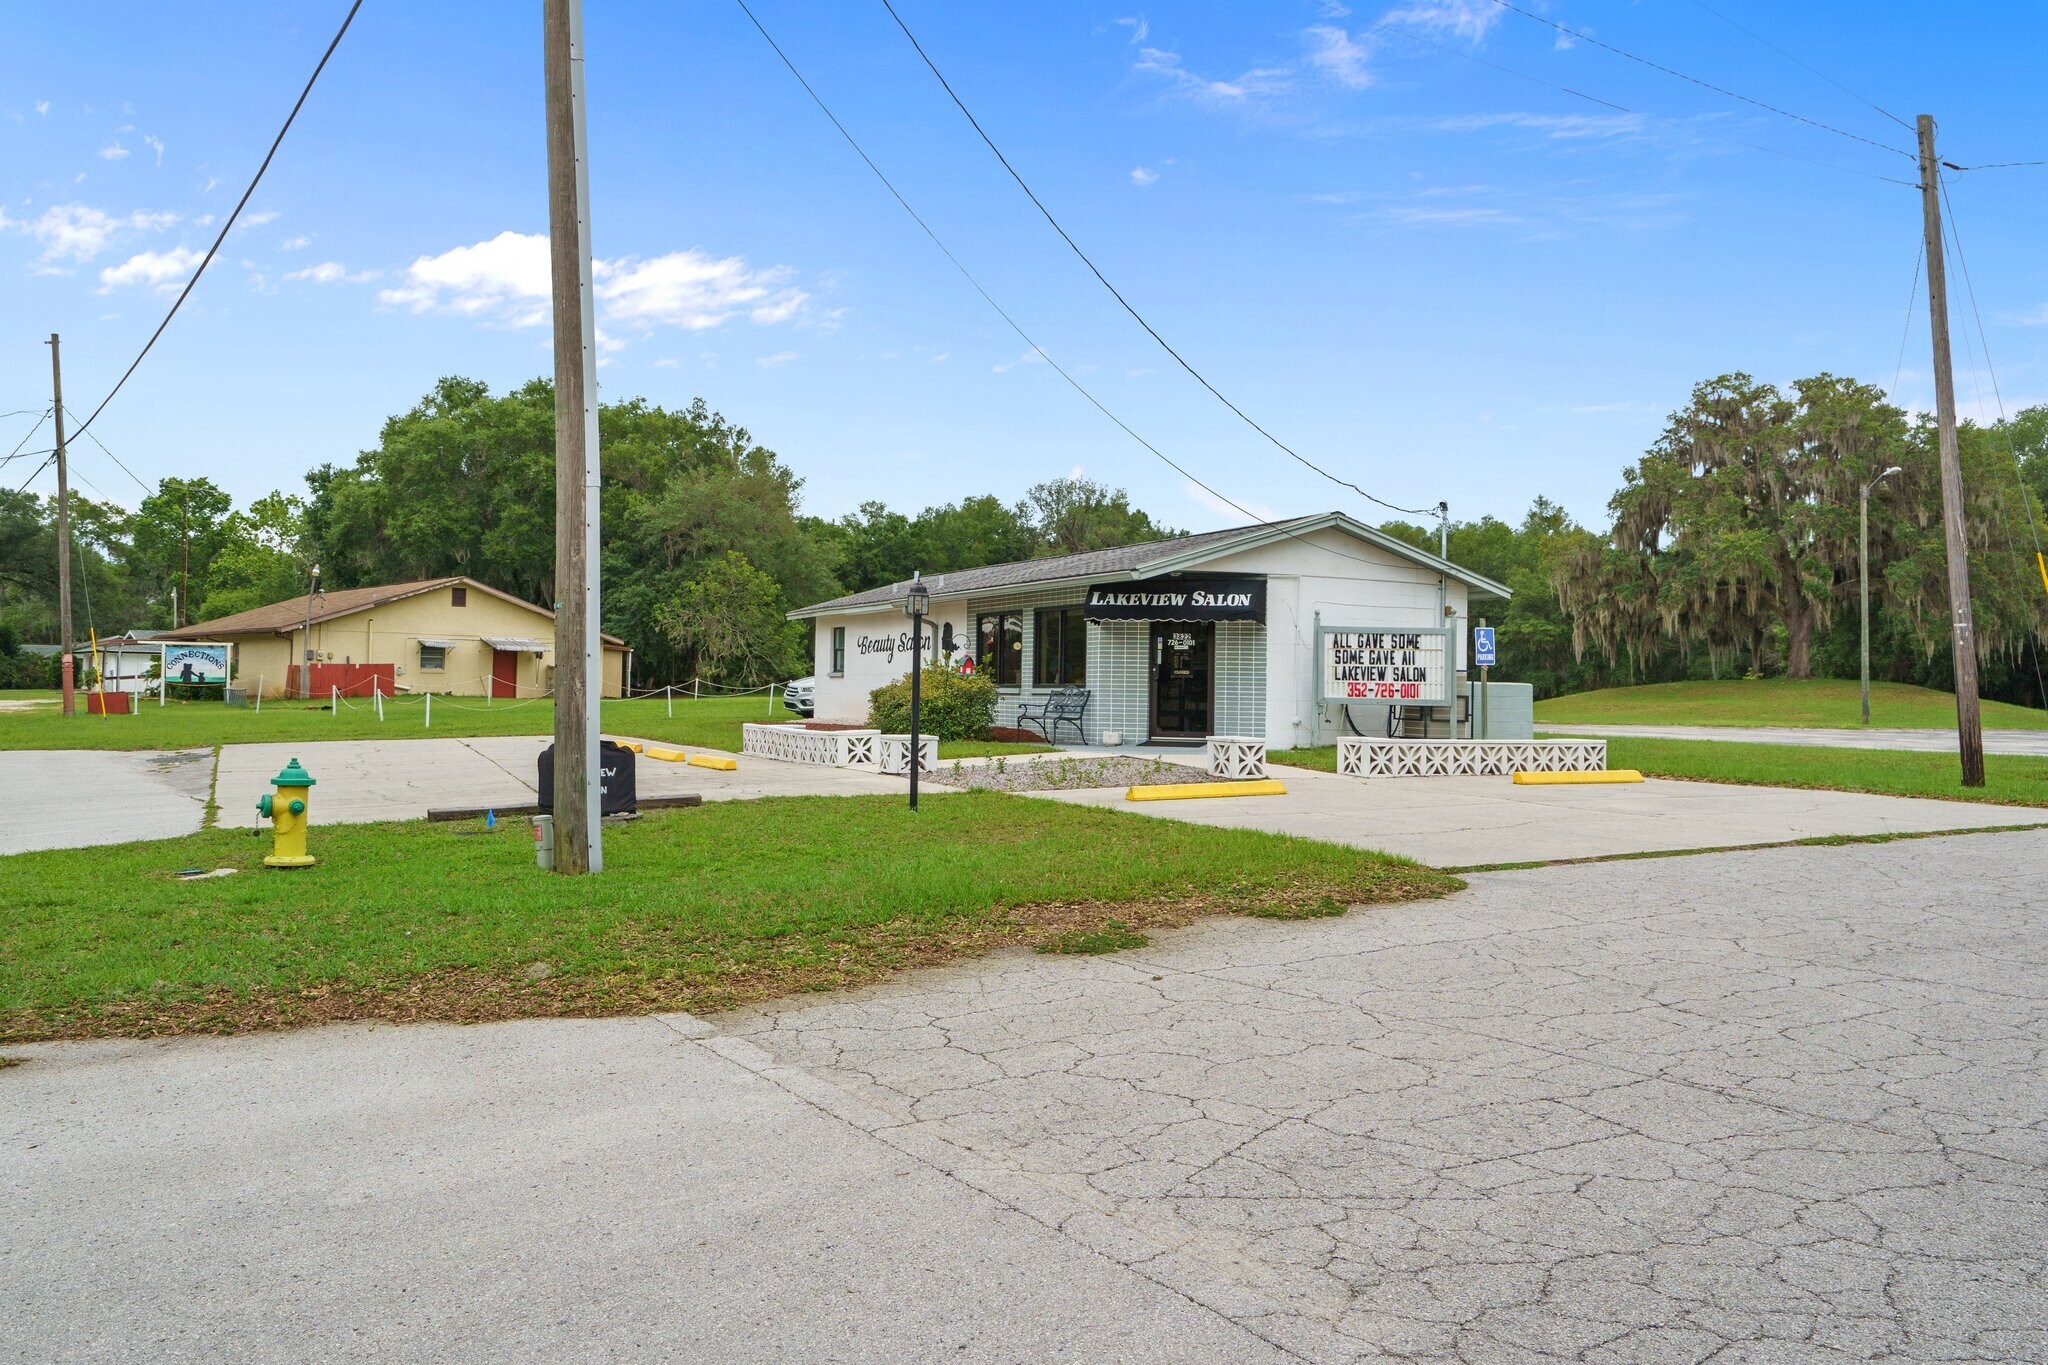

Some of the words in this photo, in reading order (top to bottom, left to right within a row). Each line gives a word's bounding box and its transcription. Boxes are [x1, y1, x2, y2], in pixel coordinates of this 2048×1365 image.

[1090, 592, 1187, 606] LAKEVIEW
[1192, 590, 1252, 607] SALON
[857, 634, 896, 664] Beauty
[897, 632, 931, 652] San
[1333, 633, 1352, 648] ALL
[1357, 633, 1385, 649] GAVE
[1391, 634, 1421, 649] SOME
[166, 650, 225, 670] CONNECTIONS
[1334, 650, 1364, 665] SOME
[1368, 651, 1395, 666] GAVE
[1334, 667, 1387, 682] LAKEVIEW
[1392, 667, 1427, 683] SALON
[1347, 682, 1420, 699] 352-726-0101
